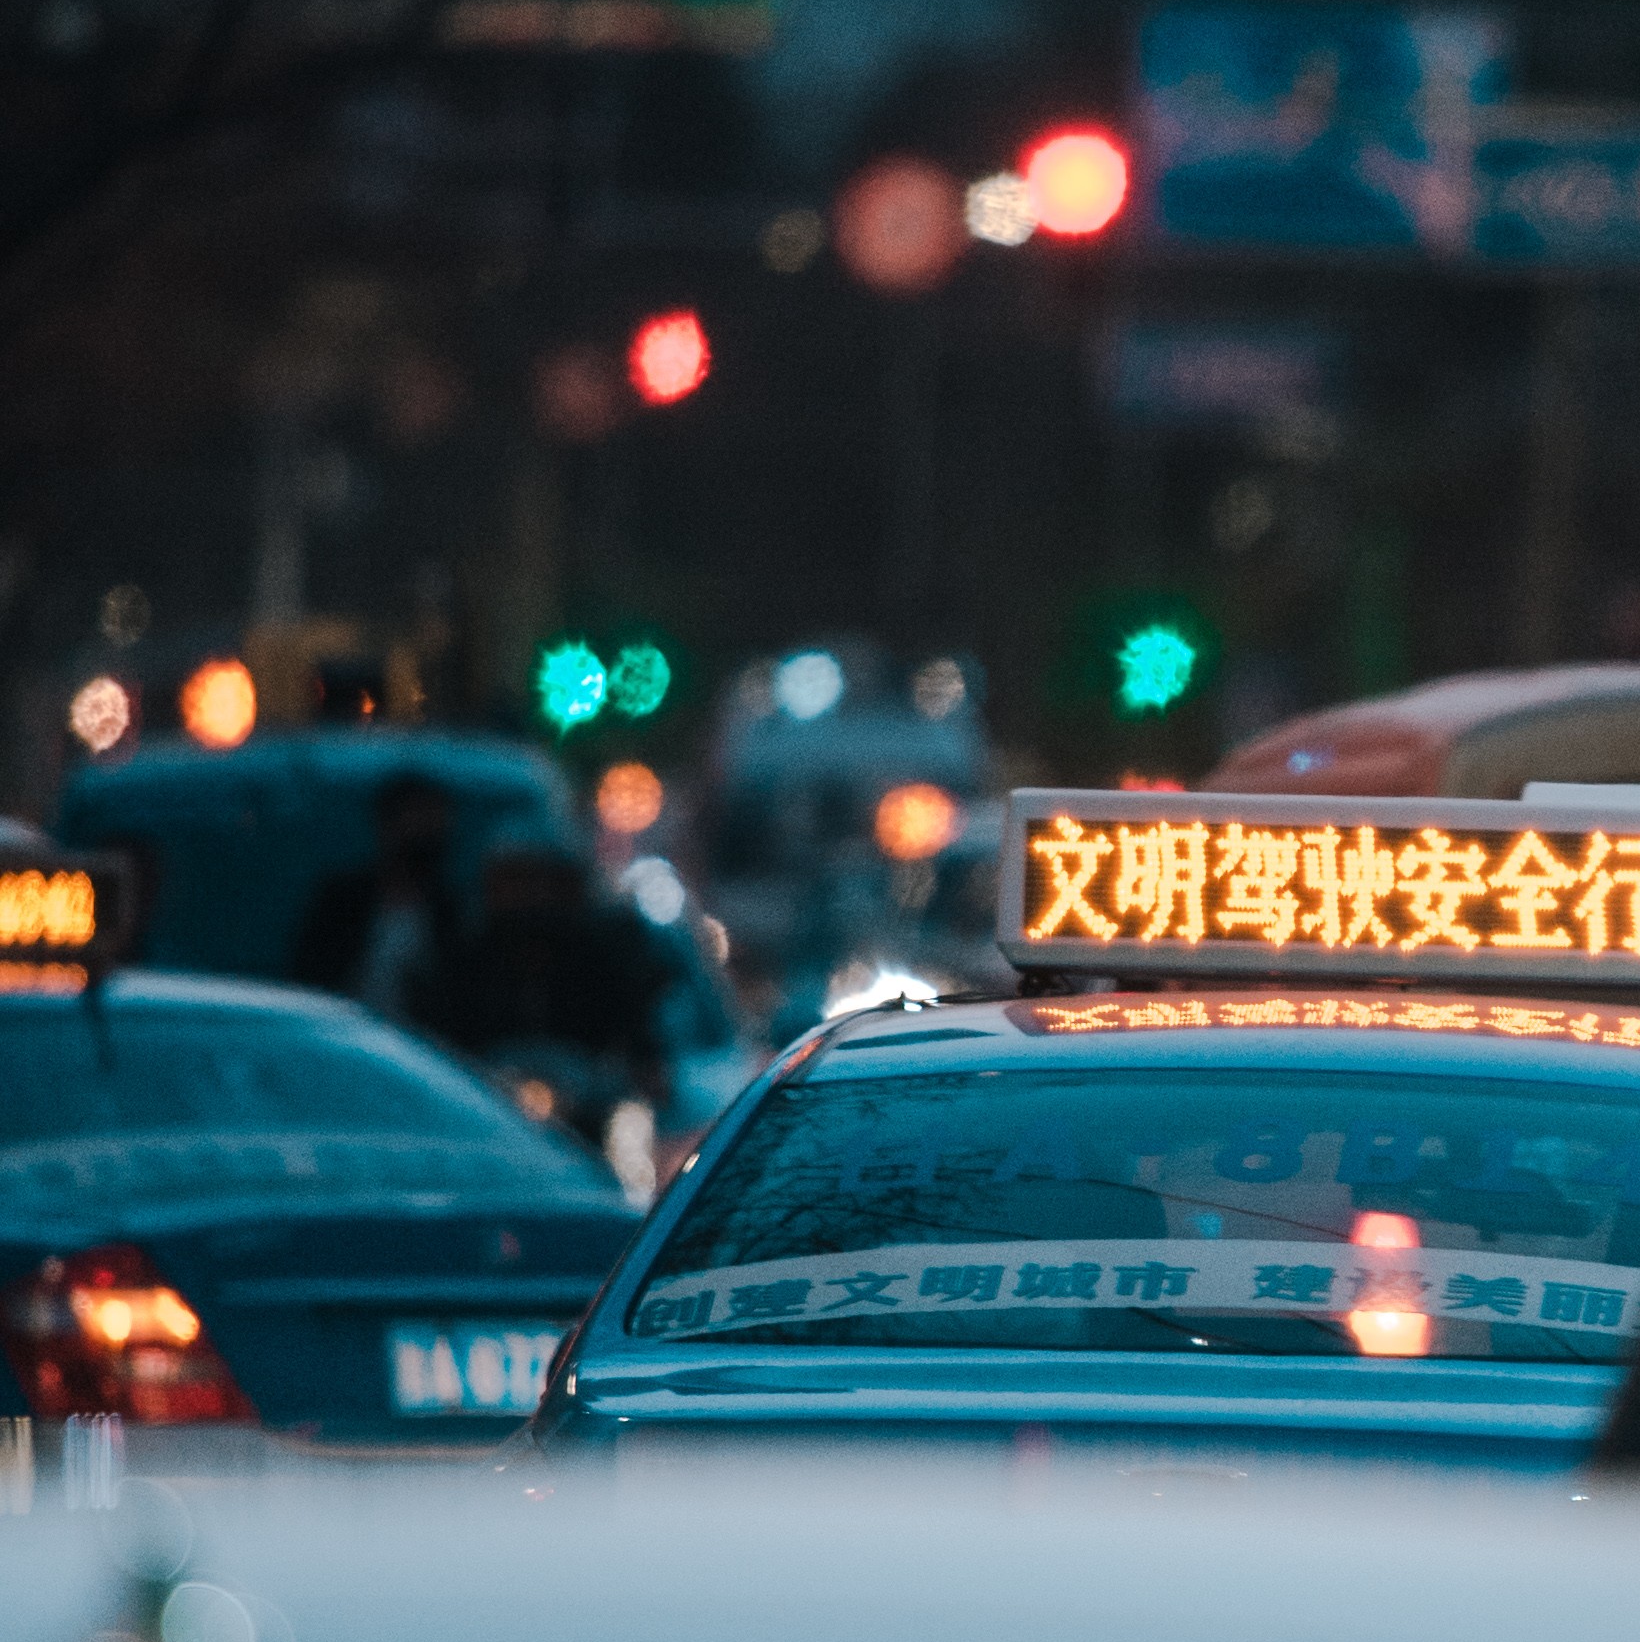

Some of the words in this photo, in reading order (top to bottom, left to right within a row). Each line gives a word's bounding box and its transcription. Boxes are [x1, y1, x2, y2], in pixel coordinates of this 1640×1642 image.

[635, 1260, 1197, 1333] 创建文明城市
